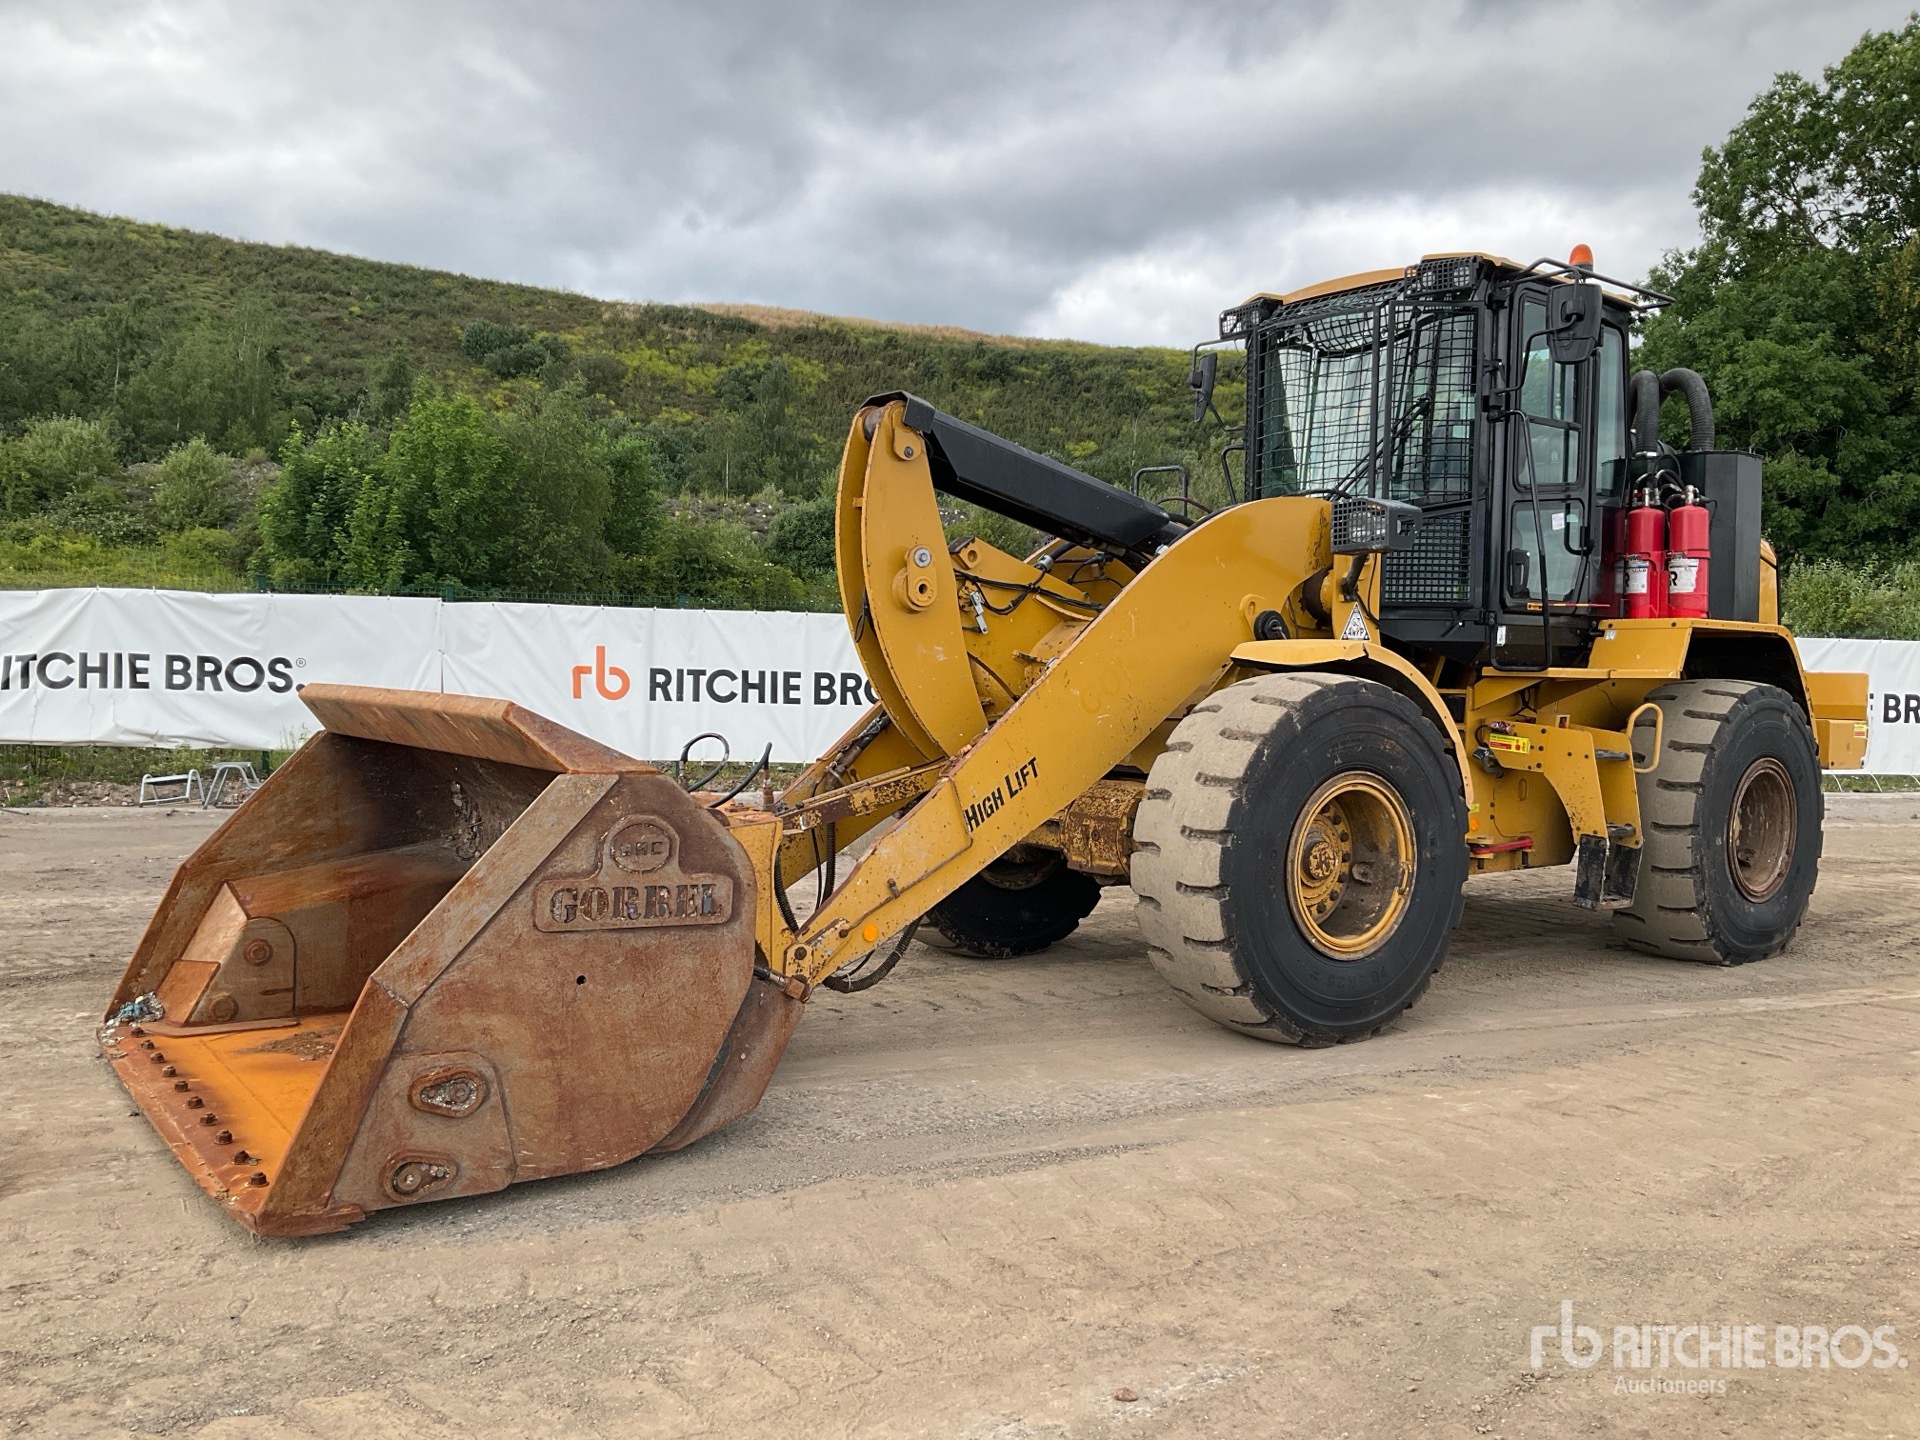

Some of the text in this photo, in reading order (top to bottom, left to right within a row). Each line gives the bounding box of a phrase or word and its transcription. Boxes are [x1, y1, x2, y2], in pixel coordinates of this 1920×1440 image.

[649, 668, 802, 705] RITCHIE
[964, 756, 1038, 833] HIGH LIFT
[551, 883, 723, 924] GORREL
